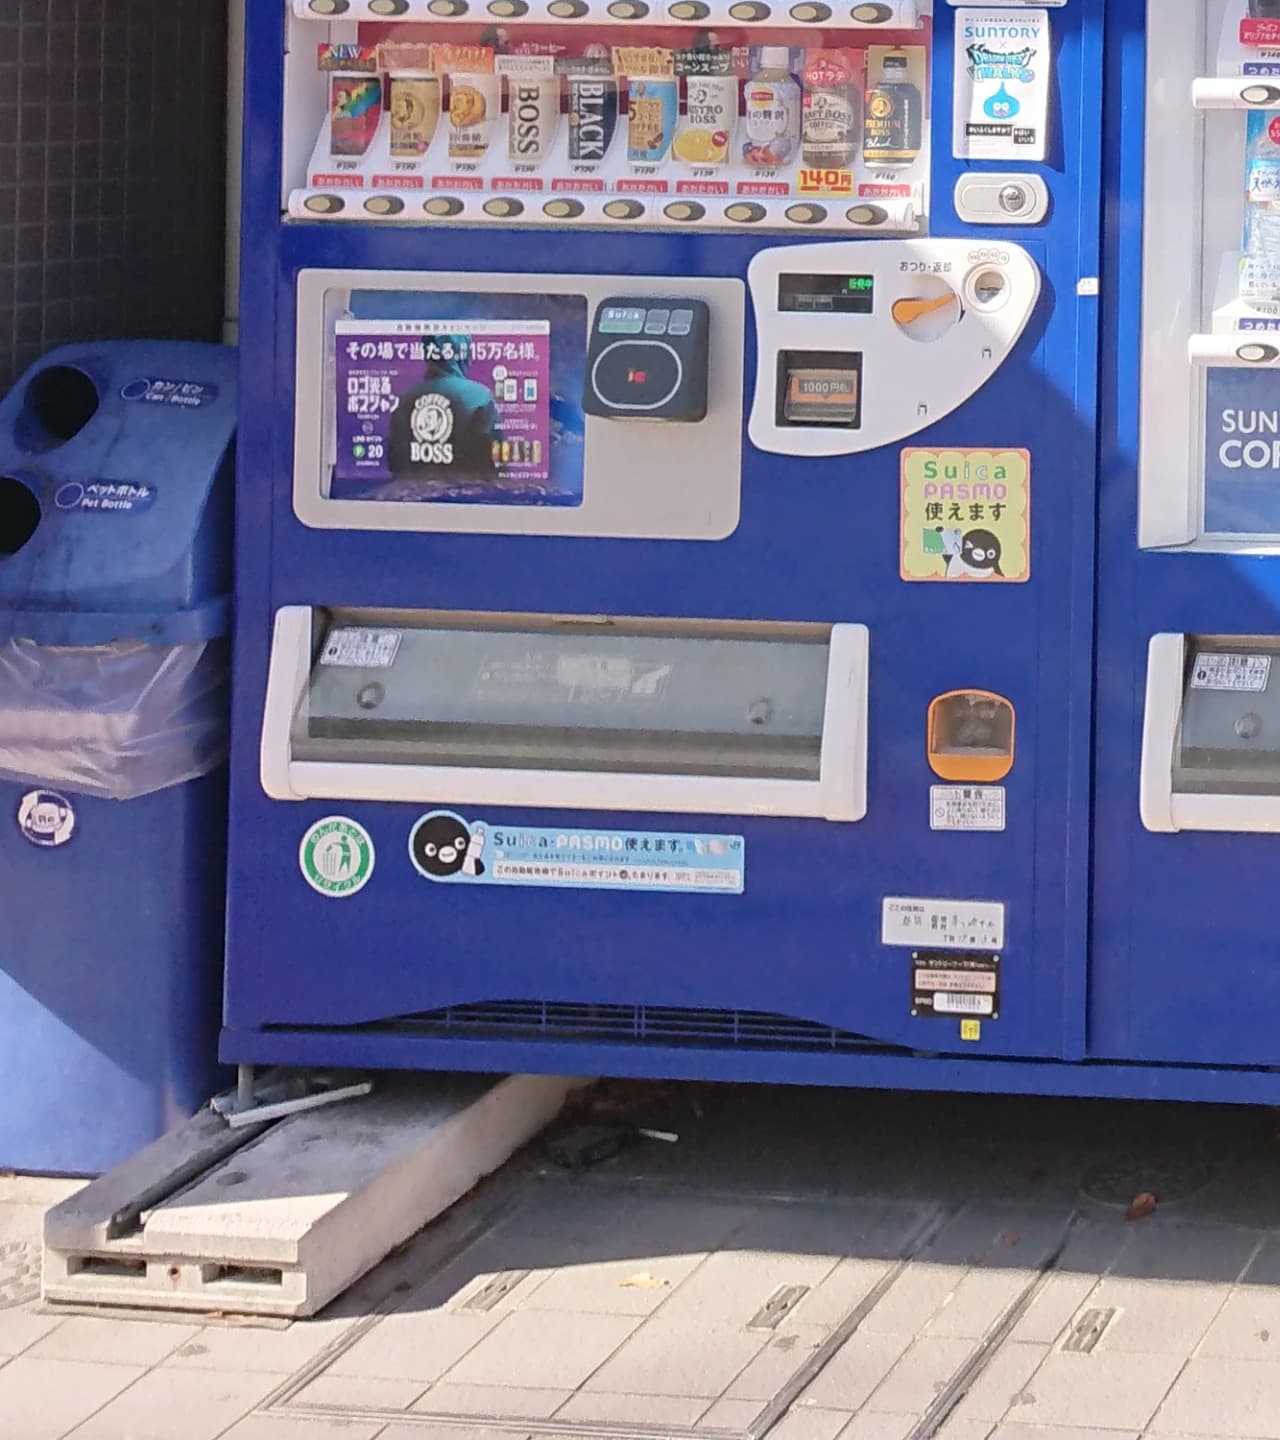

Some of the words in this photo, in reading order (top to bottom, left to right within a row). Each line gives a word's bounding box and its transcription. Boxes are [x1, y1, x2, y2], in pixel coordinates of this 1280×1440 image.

[964, 25, 1040, 39] SUNTORY
[327, 46, 363, 59] NEW
[675, 62, 730, 73] コーンスープ
[517, 85, 540, 155] BOSS
[579, 82, 604, 157] BLACK
[800, 170, 851, 187] 140円
[368, 445, 384, 458] 20
[410, 441, 454, 465] BOSS
[923, 461, 1007, 480] Suica
[923, 483, 1007, 500] PASMO
[101, 497, 133, 510] Bottle
[924, 502, 1007, 522] 使えます
